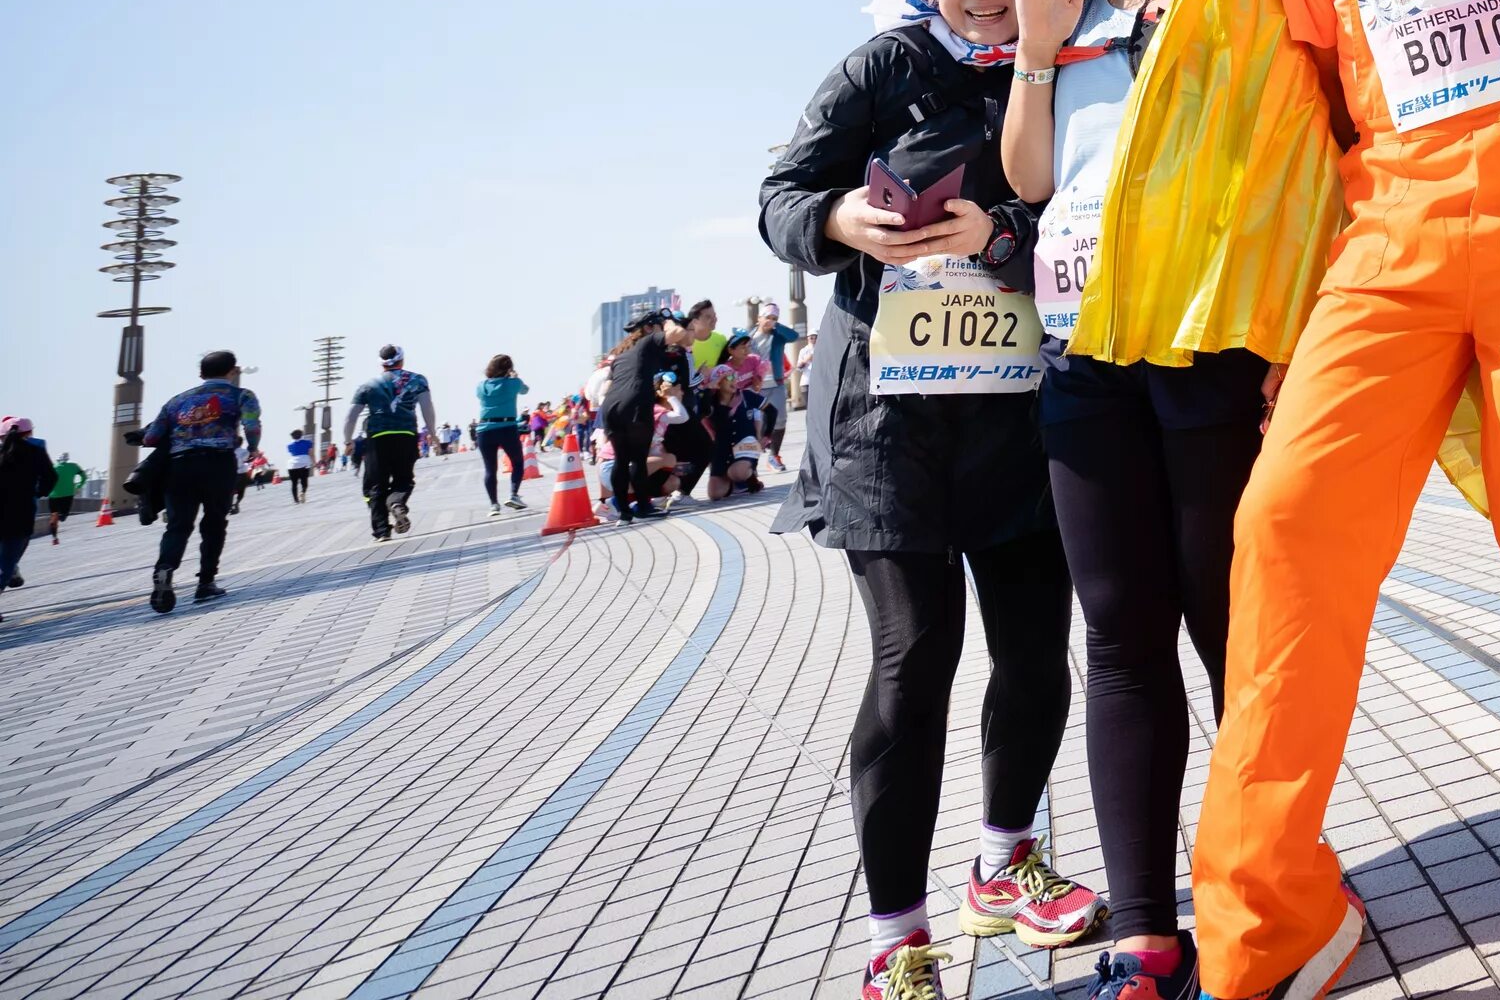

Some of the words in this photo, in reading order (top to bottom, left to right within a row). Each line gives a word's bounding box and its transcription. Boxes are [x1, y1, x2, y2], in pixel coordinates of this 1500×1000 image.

[1053, 254, 1095, 294] B0
[941, 294, 995, 307] JAPAN
[909, 310, 1018, 348] C1022
[879, 365, 1041, 382] 近畿日本ツーリスト
